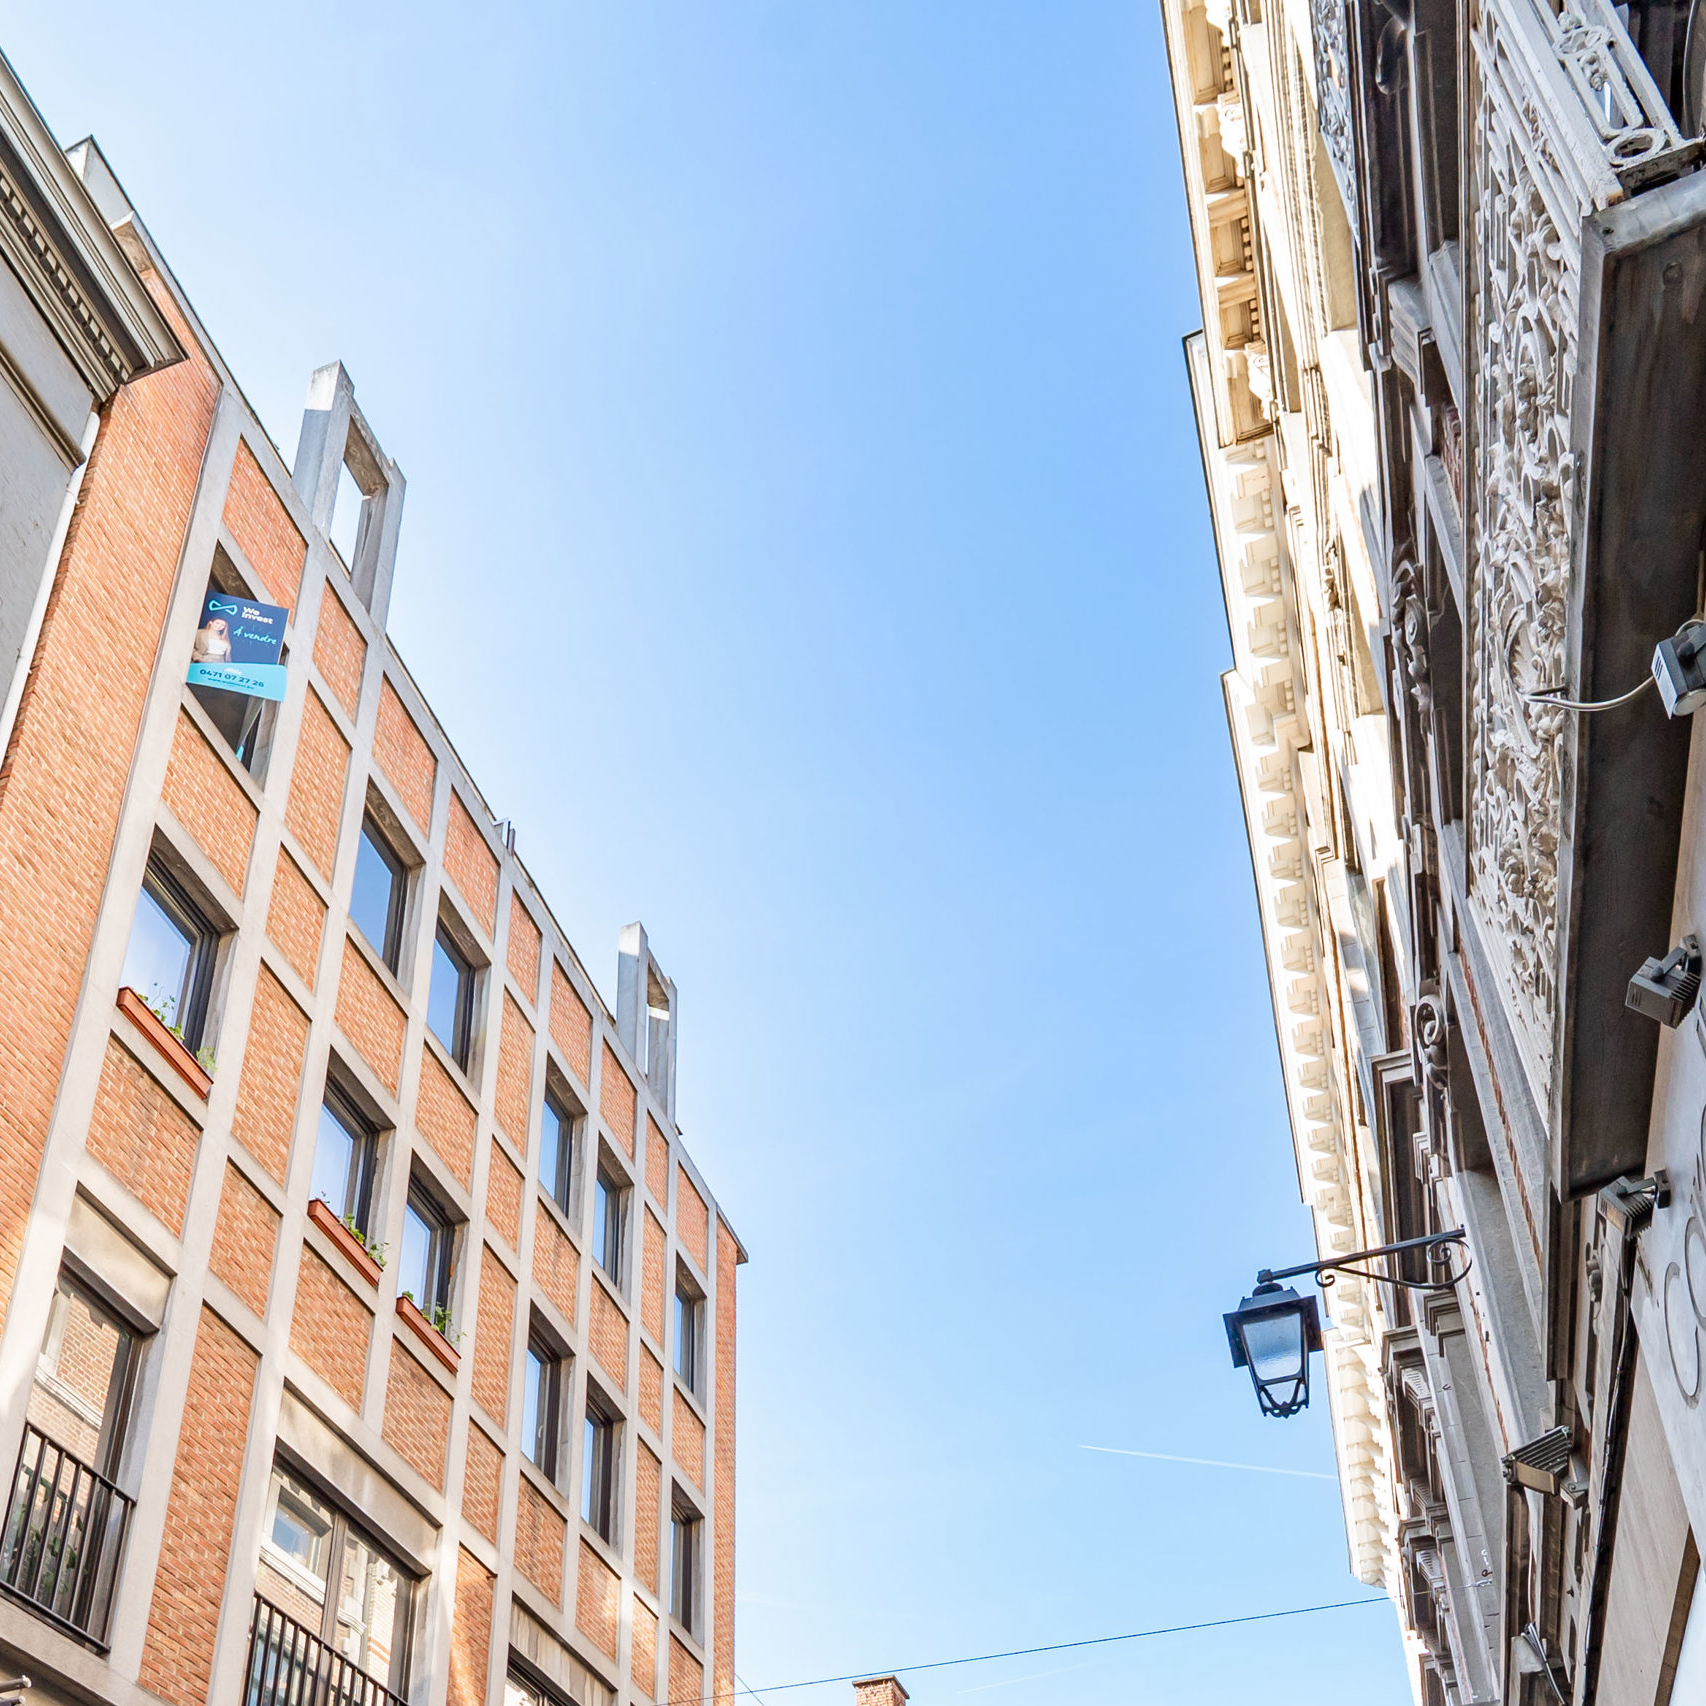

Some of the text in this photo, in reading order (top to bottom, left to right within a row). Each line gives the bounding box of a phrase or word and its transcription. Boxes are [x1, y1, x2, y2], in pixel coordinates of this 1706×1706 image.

[244, 632, 277, 645] vendre
[199, 668, 223, 678] 0471
[224, 673, 237, 681] 07
